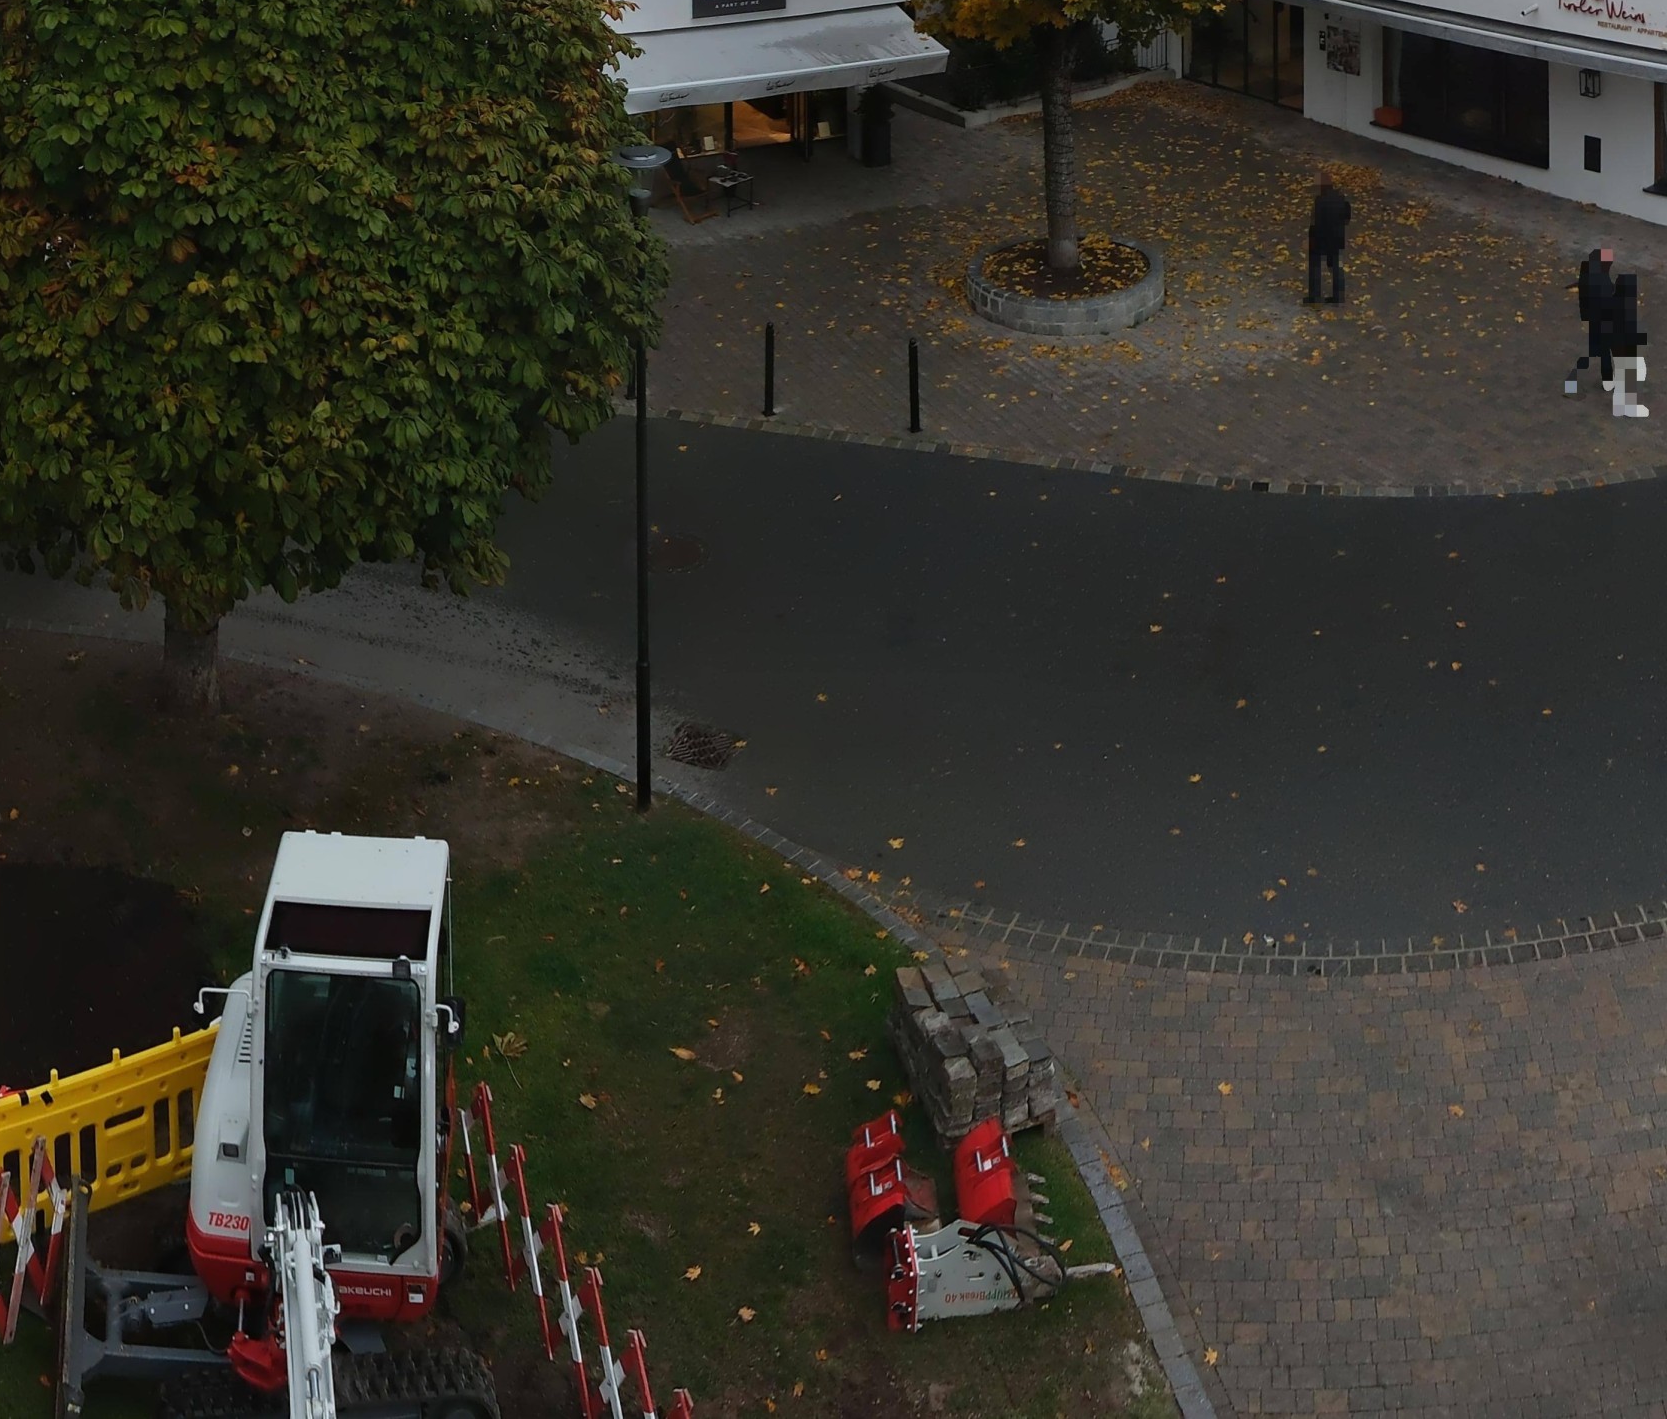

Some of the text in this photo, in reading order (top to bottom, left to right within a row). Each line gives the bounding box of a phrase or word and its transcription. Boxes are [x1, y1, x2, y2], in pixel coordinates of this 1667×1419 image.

[1597, 21, 1632, 32] RESTAURANT
[208, 1211, 250, 1231] TB230
[339, 1287, 392, 1297] AKEUCHI
[944, 1293, 958, 1303] 40
